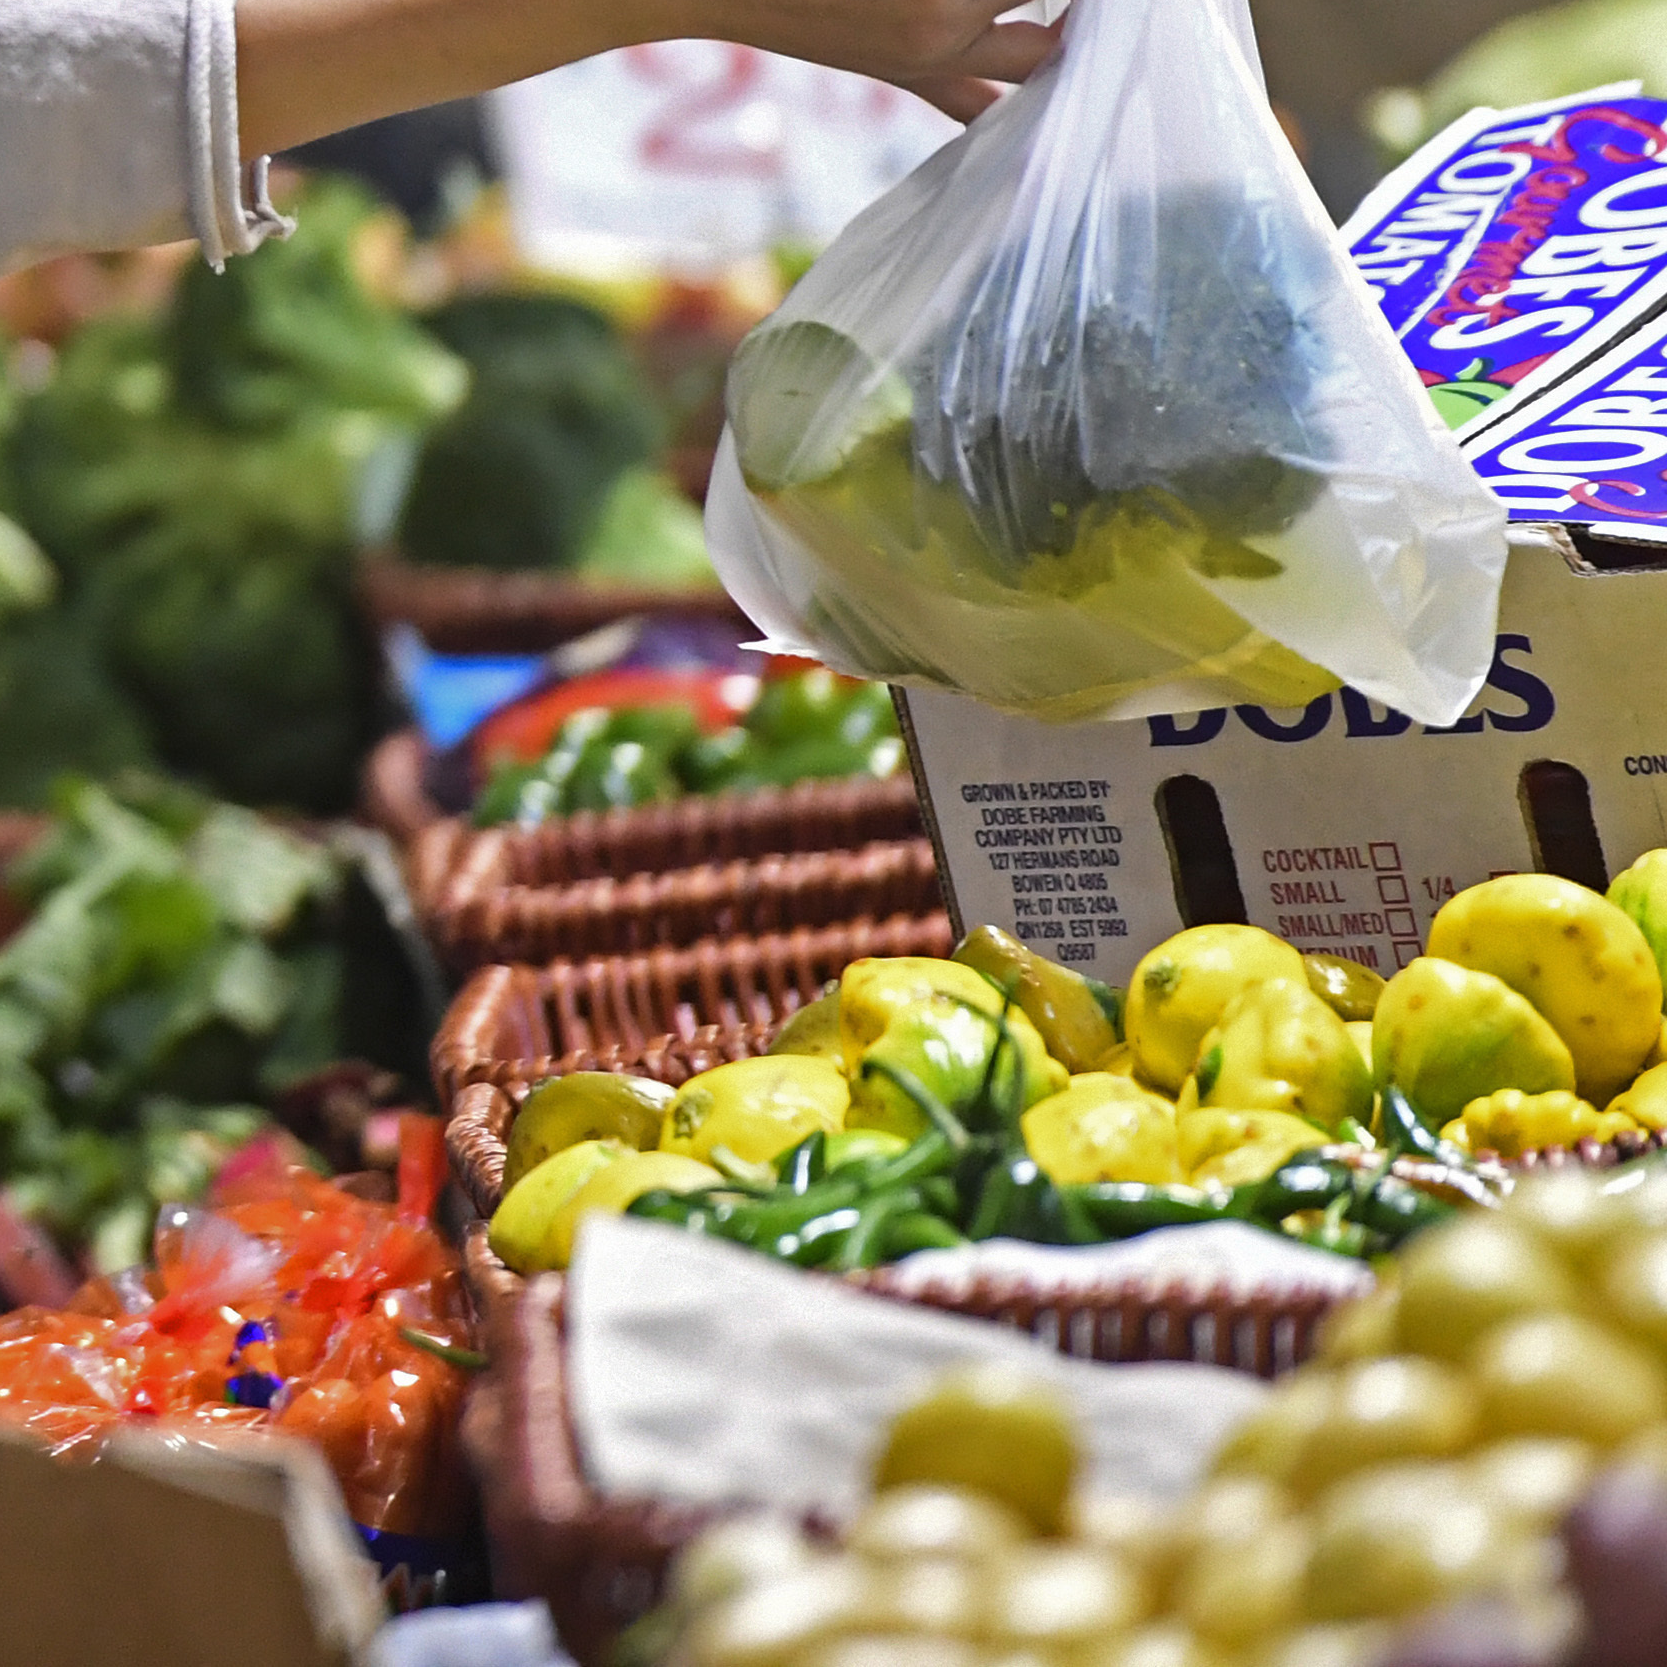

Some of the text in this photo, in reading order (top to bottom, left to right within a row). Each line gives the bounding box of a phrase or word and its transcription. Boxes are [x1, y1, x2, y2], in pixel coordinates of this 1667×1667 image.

[1352, 114, 1566, 304] TOMAT
[1428, 117, 1667, 350] OBES
[1481, 336, 1667, 513] DOB
[961, 784, 1016, 803] GROWN
[1019, 783, 1029, 801] &
[1030, 780, 1087, 800] PACKED
[981, 805, 1105, 826] DOBE FARMING
[975, 825, 1122, 847] COMPANY PTY LTD
[989, 849, 1120, 870] 127 HERMANS ROAD
[1263, 847, 1369, 873] COCKTAIL
[1012, 874, 1063, 893] BOWEN
[1064, 873, 1076, 892] Q
[1269, 880, 1346, 905] SMALL
[1069, 919, 1095, 937] EST
[1277, 912, 1385, 938] SMALL/MED
[1297, 945, 1379, 968] IUM
